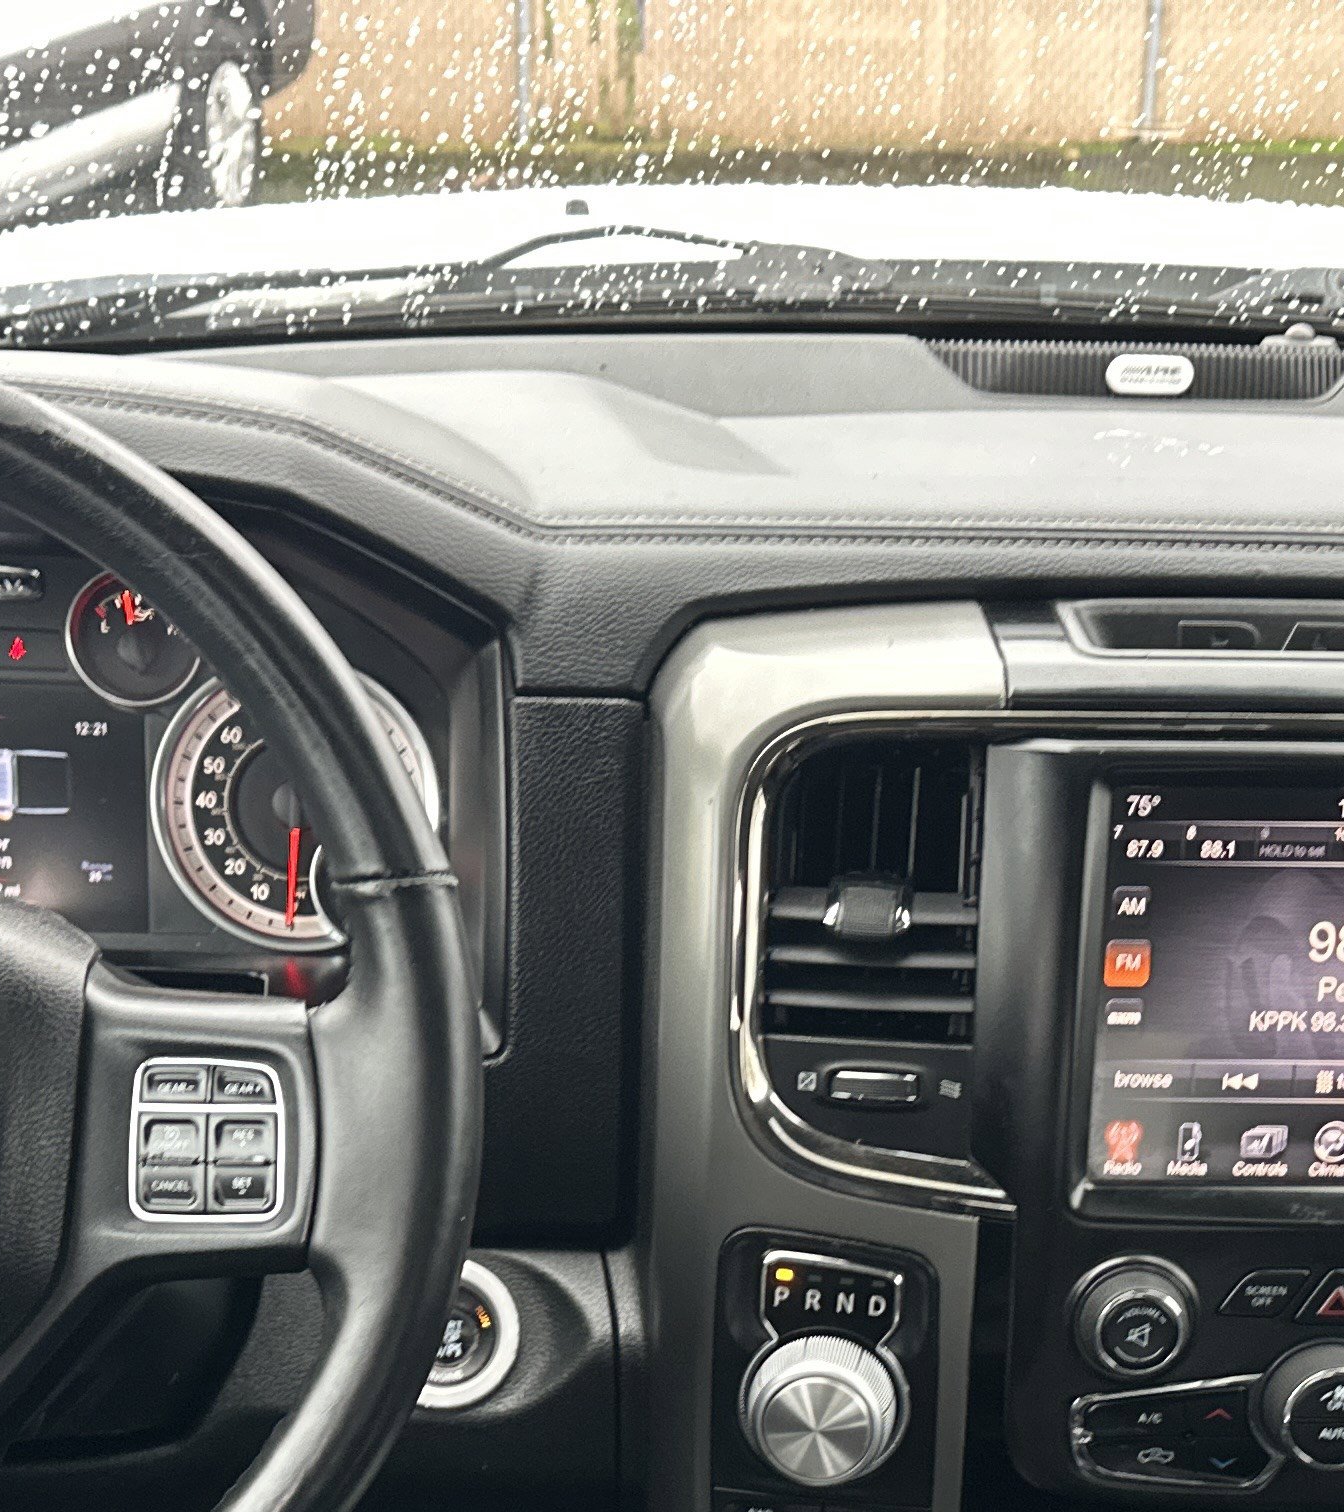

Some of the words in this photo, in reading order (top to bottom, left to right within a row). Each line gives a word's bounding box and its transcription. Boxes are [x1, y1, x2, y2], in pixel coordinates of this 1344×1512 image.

[74, 720, 108, 737] 12:21
[220, 725, 243, 744] 60
[203, 755, 226, 775] 50
[195, 790, 218, 810] 40
[203, 827, 226, 846] 30
[224, 857, 247, 876] 20
[250, 882, 271, 901] 10
[1116, 897, 1147, 916] AM
[1114, 952, 1143, 972] FM
[1248, 1009, 1308, 1033] KPPK
[1113, 1069, 1174, 1090] browse
[1102, 1158, 1143, 1177] Radio
[1166, 1159, 1208, 1177] Media
[1231, 1159, 1289, 1178] Controls
[773, 1285, 791, 1307] P
[804, 1288, 823, 1312] R
[835, 1291, 855, 1315] N
[867, 1294, 888, 1317] D
[1137, 1409, 1163, 1426] A/C
